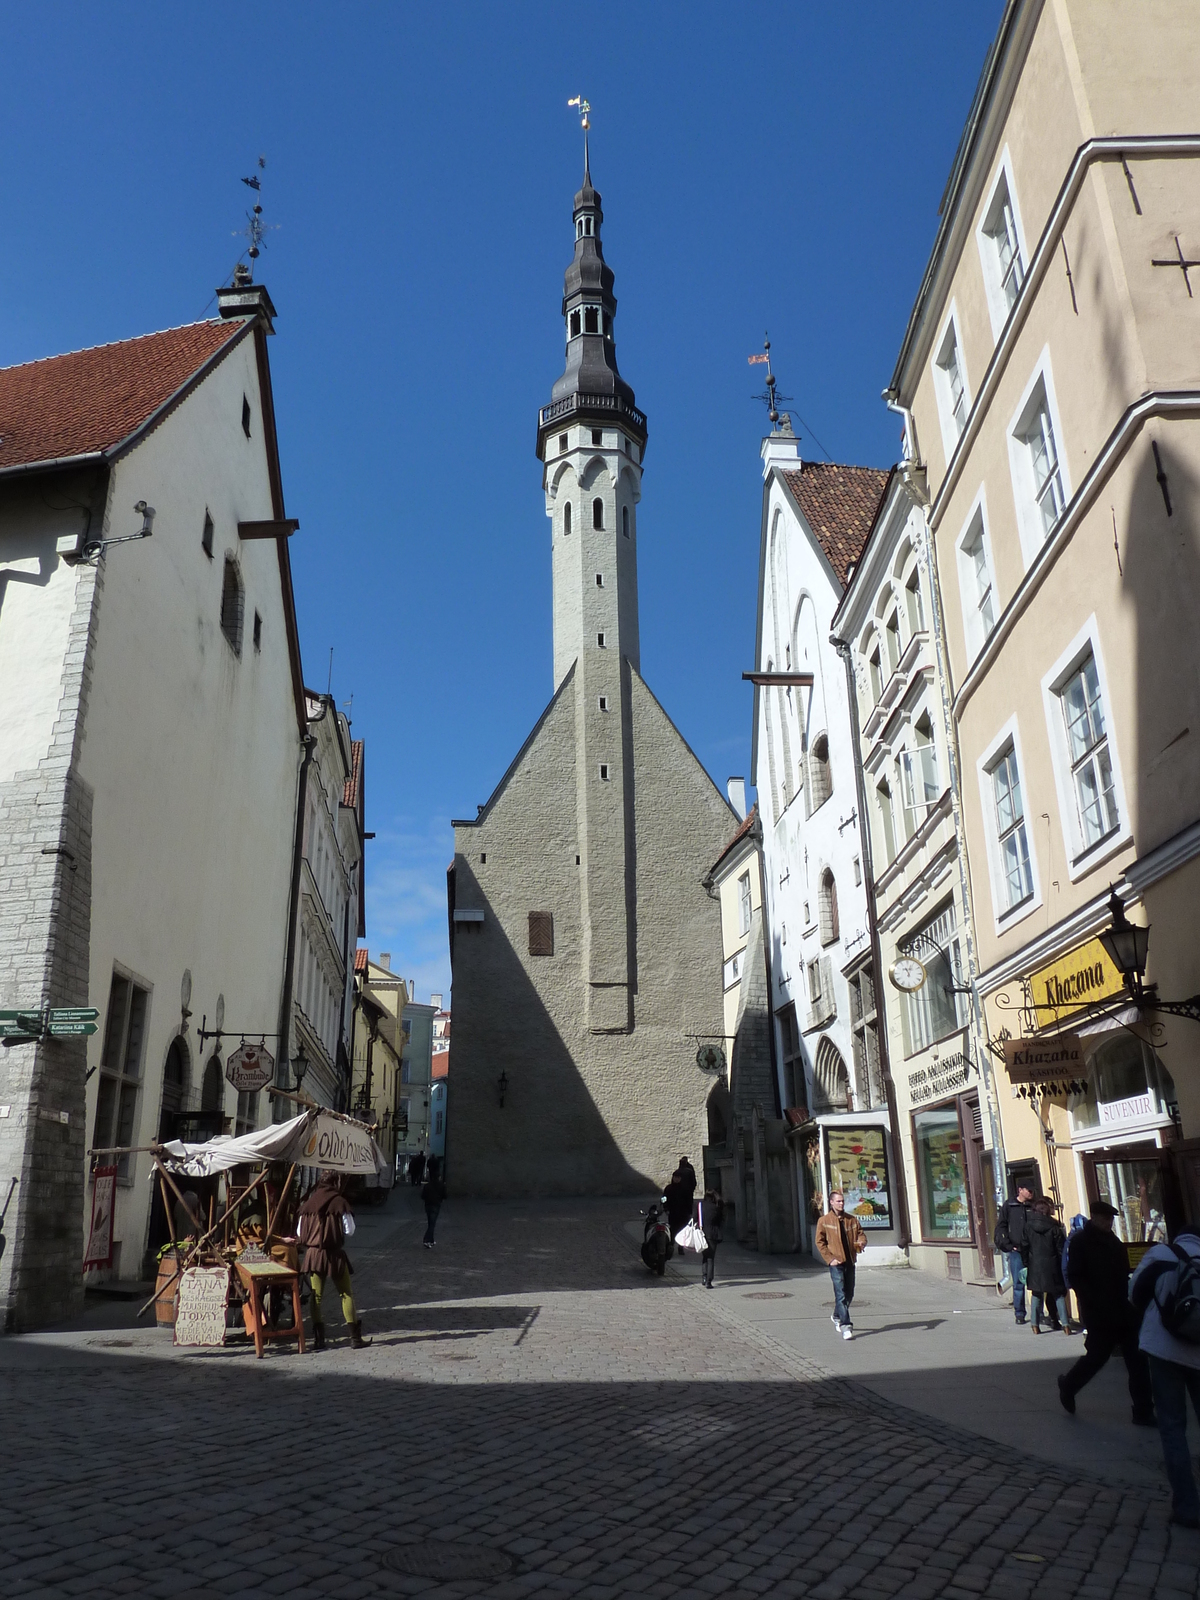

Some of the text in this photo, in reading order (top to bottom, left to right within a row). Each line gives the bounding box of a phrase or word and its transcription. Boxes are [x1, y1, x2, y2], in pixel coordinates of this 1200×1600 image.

[1044, 961, 1104, 1006] Khazana
[1012, 1049, 1079, 1066] Khazana
[1103, 1097, 1152, 1121] SUVENIIR
[180, 1311, 219, 1321] TODAY
[177, 1326, 218, 1335] MEDIEVAL
[177, 1333, 223, 1343] MUSICIANS
